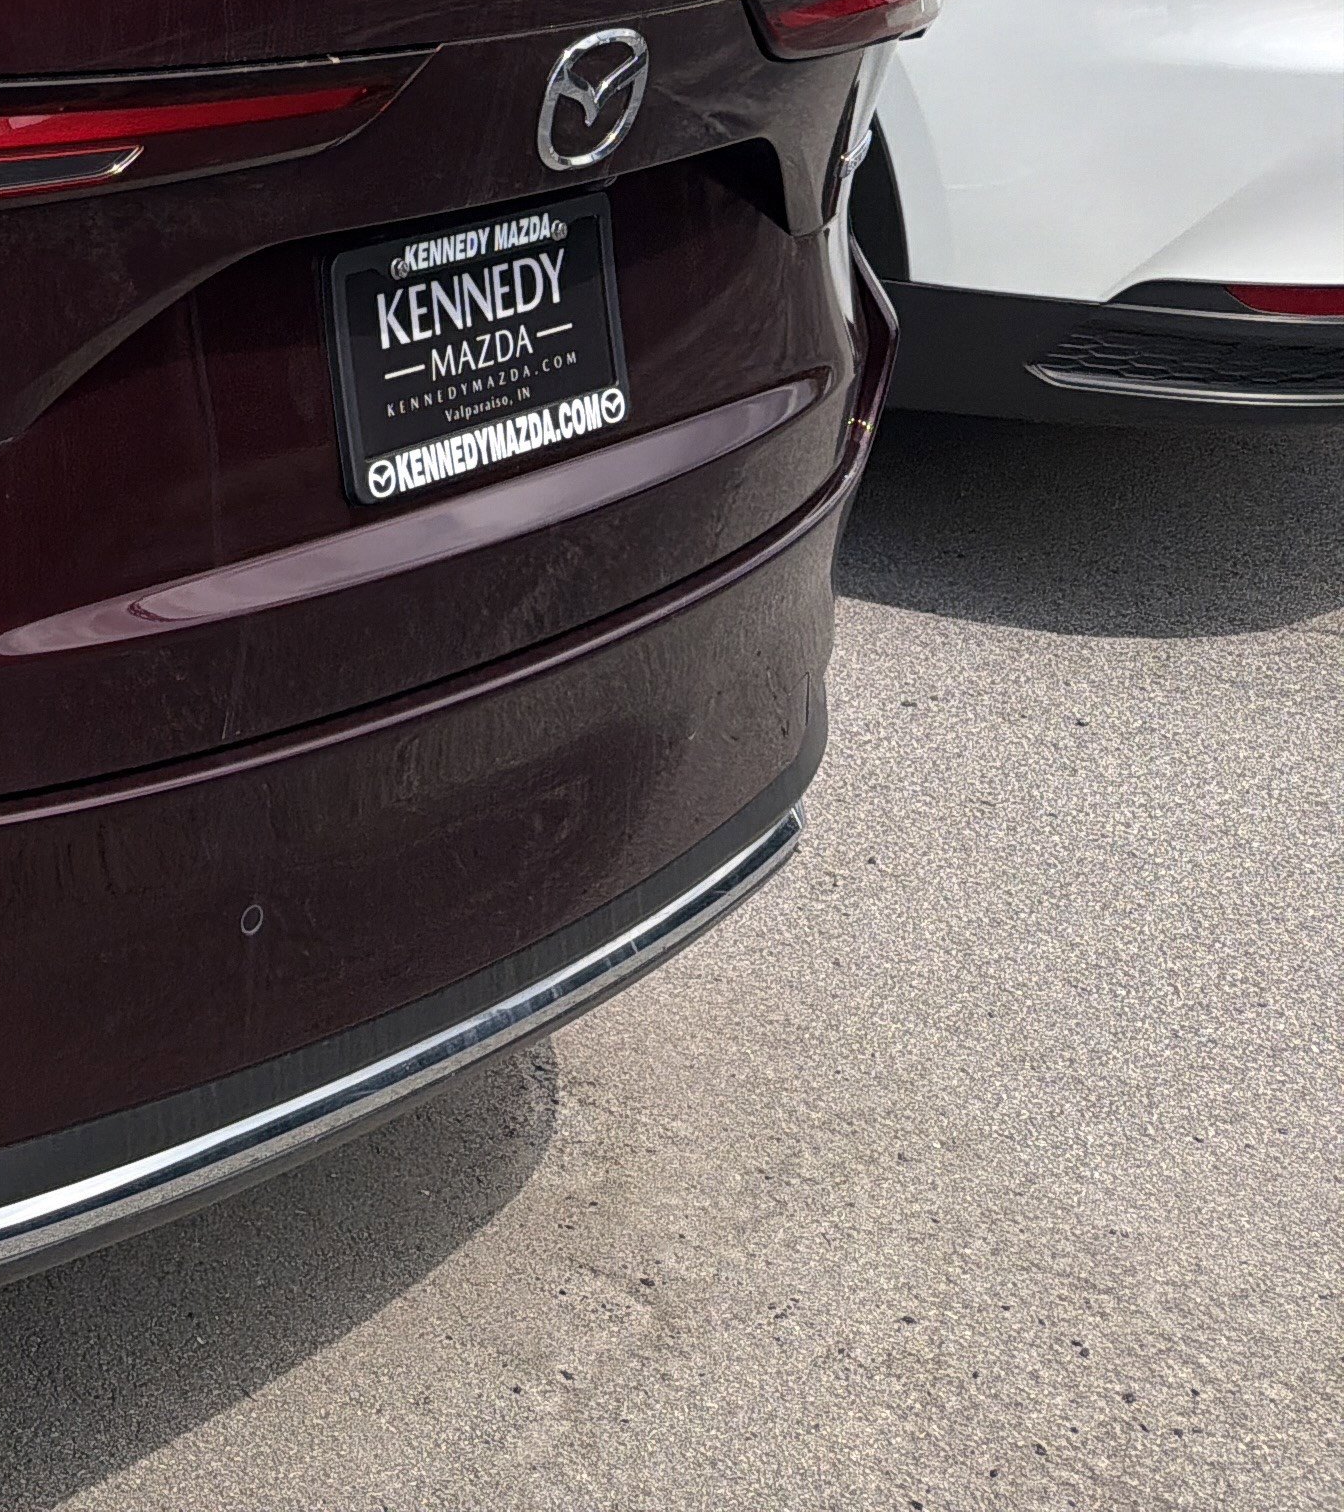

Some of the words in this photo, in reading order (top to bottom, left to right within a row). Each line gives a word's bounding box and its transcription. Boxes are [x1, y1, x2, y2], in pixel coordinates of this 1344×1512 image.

[404, 227, 490, 271] KENNEDY
[494, 213, 551, 250] MAZDA
[376, 248, 565, 349] KENNEDY
[431, 324, 533, 381] MAZDA
[386, 351, 577, 418] KENNEDYMAZDA.COM
[444, 395, 513, 422] Valparaiso,
[517, 386, 531, 402] IN
[395, 392, 603, 493] KENNEDYMAZDA.COM
